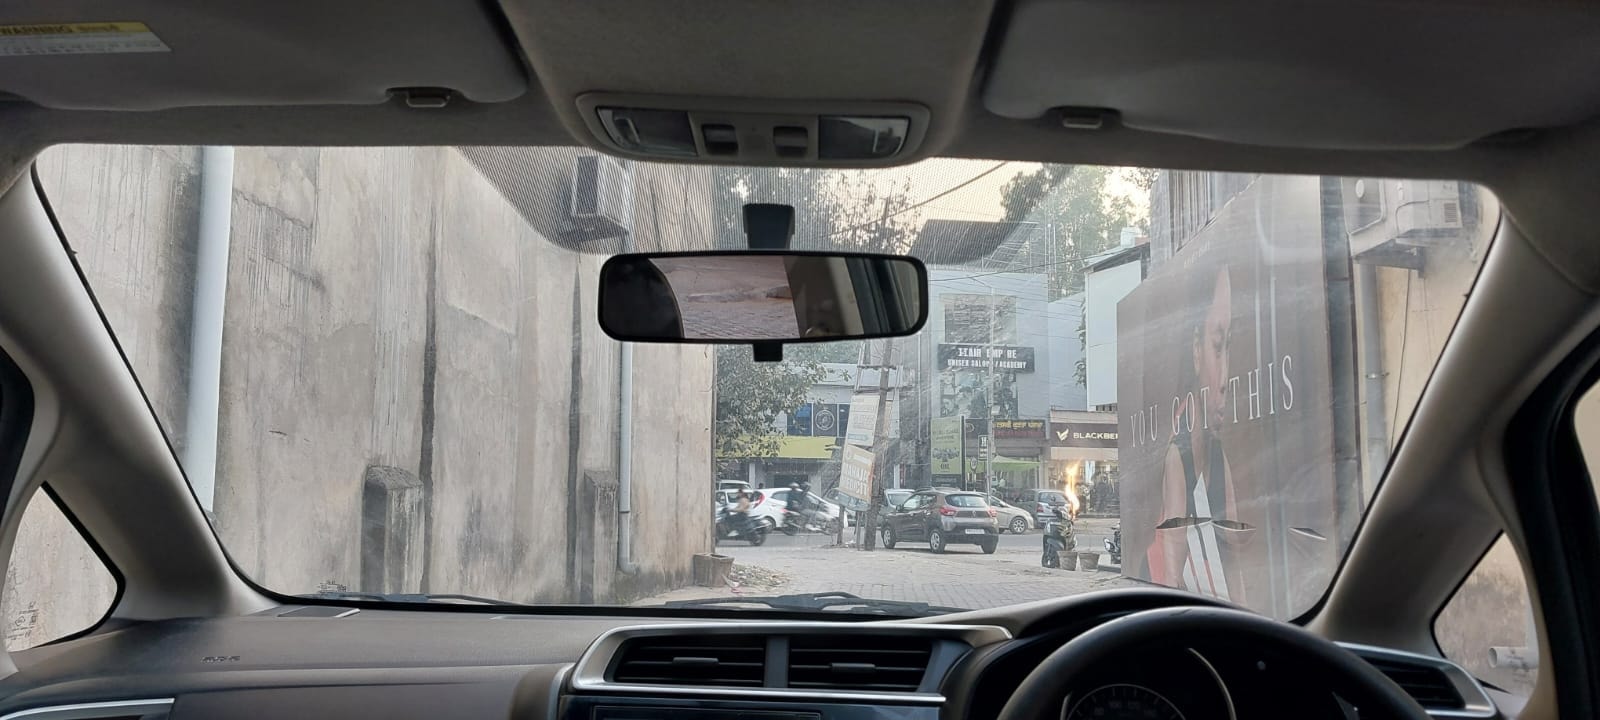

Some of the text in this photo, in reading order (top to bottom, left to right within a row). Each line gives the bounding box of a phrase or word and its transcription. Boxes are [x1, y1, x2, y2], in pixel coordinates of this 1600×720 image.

[958, 347, 1017, 359] HAIR EMPRE
[1130, 355, 1294, 448] YOU GOT THIS
